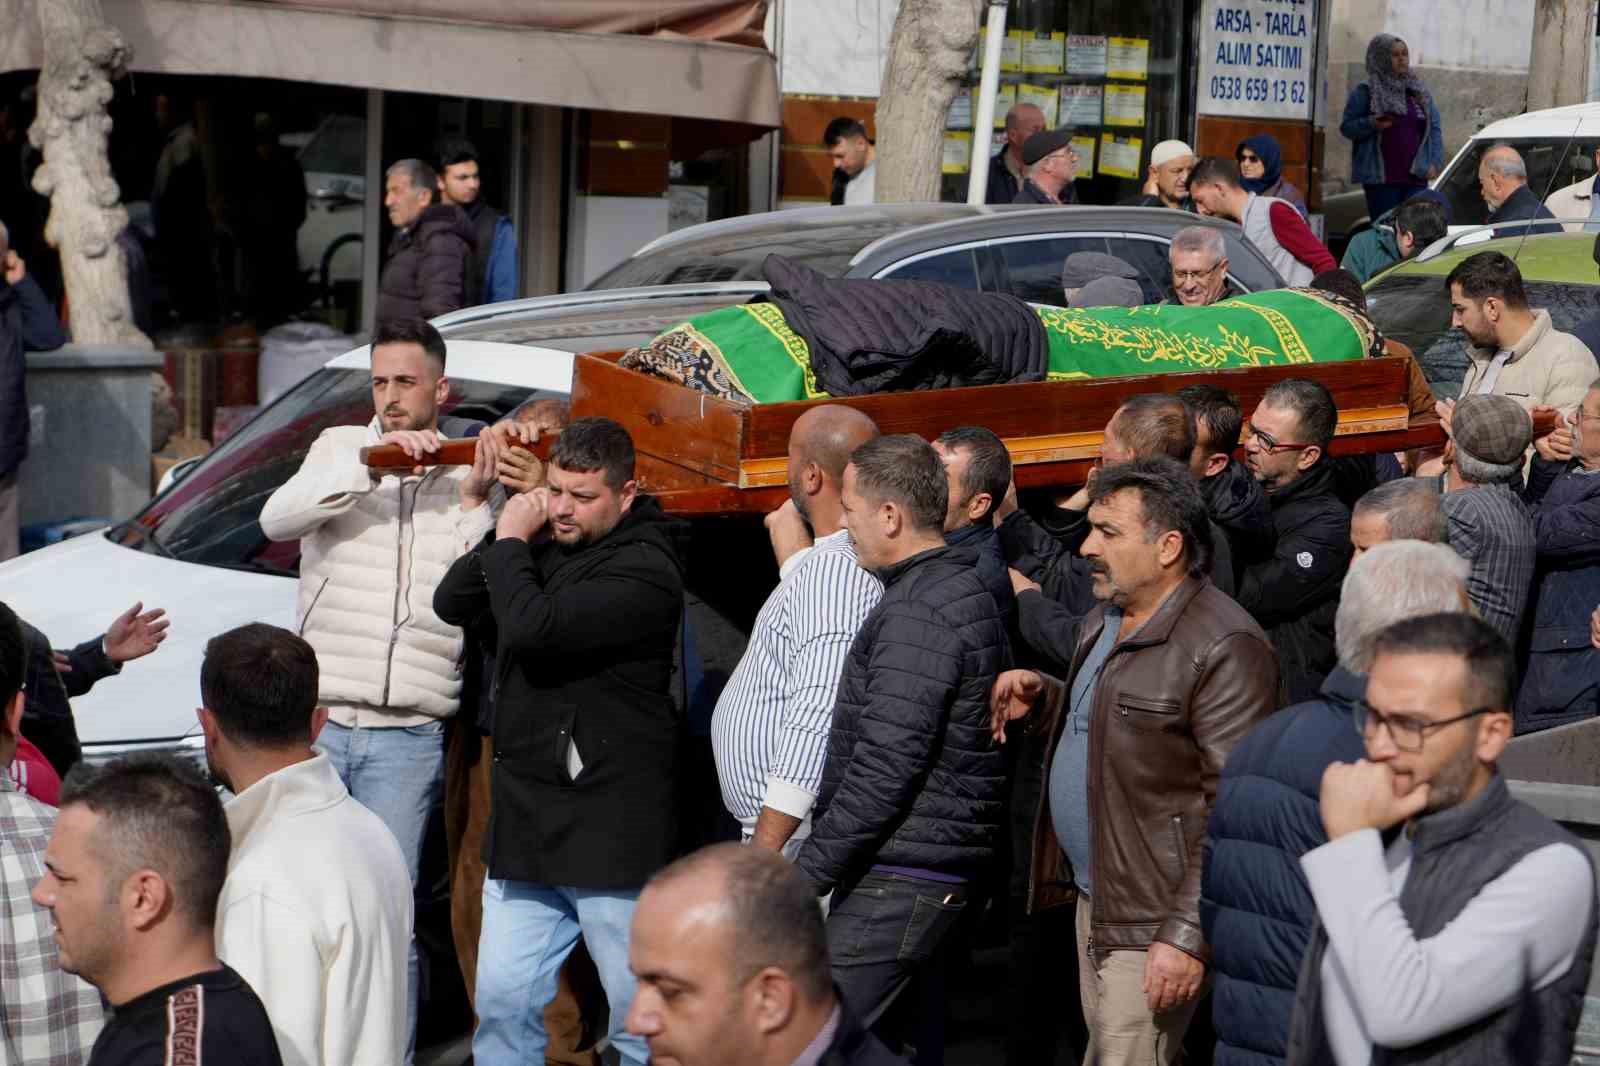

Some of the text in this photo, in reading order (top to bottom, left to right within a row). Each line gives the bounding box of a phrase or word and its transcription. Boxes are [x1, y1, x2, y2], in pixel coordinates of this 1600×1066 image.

[1215, 8, 1251, 33] ARSA
[1265, 12, 1306, 37] TARLA
[1216, 42, 1302, 69] ALIM SATIMI
[1211, 76, 1305, 104] 0538 659 13 62
